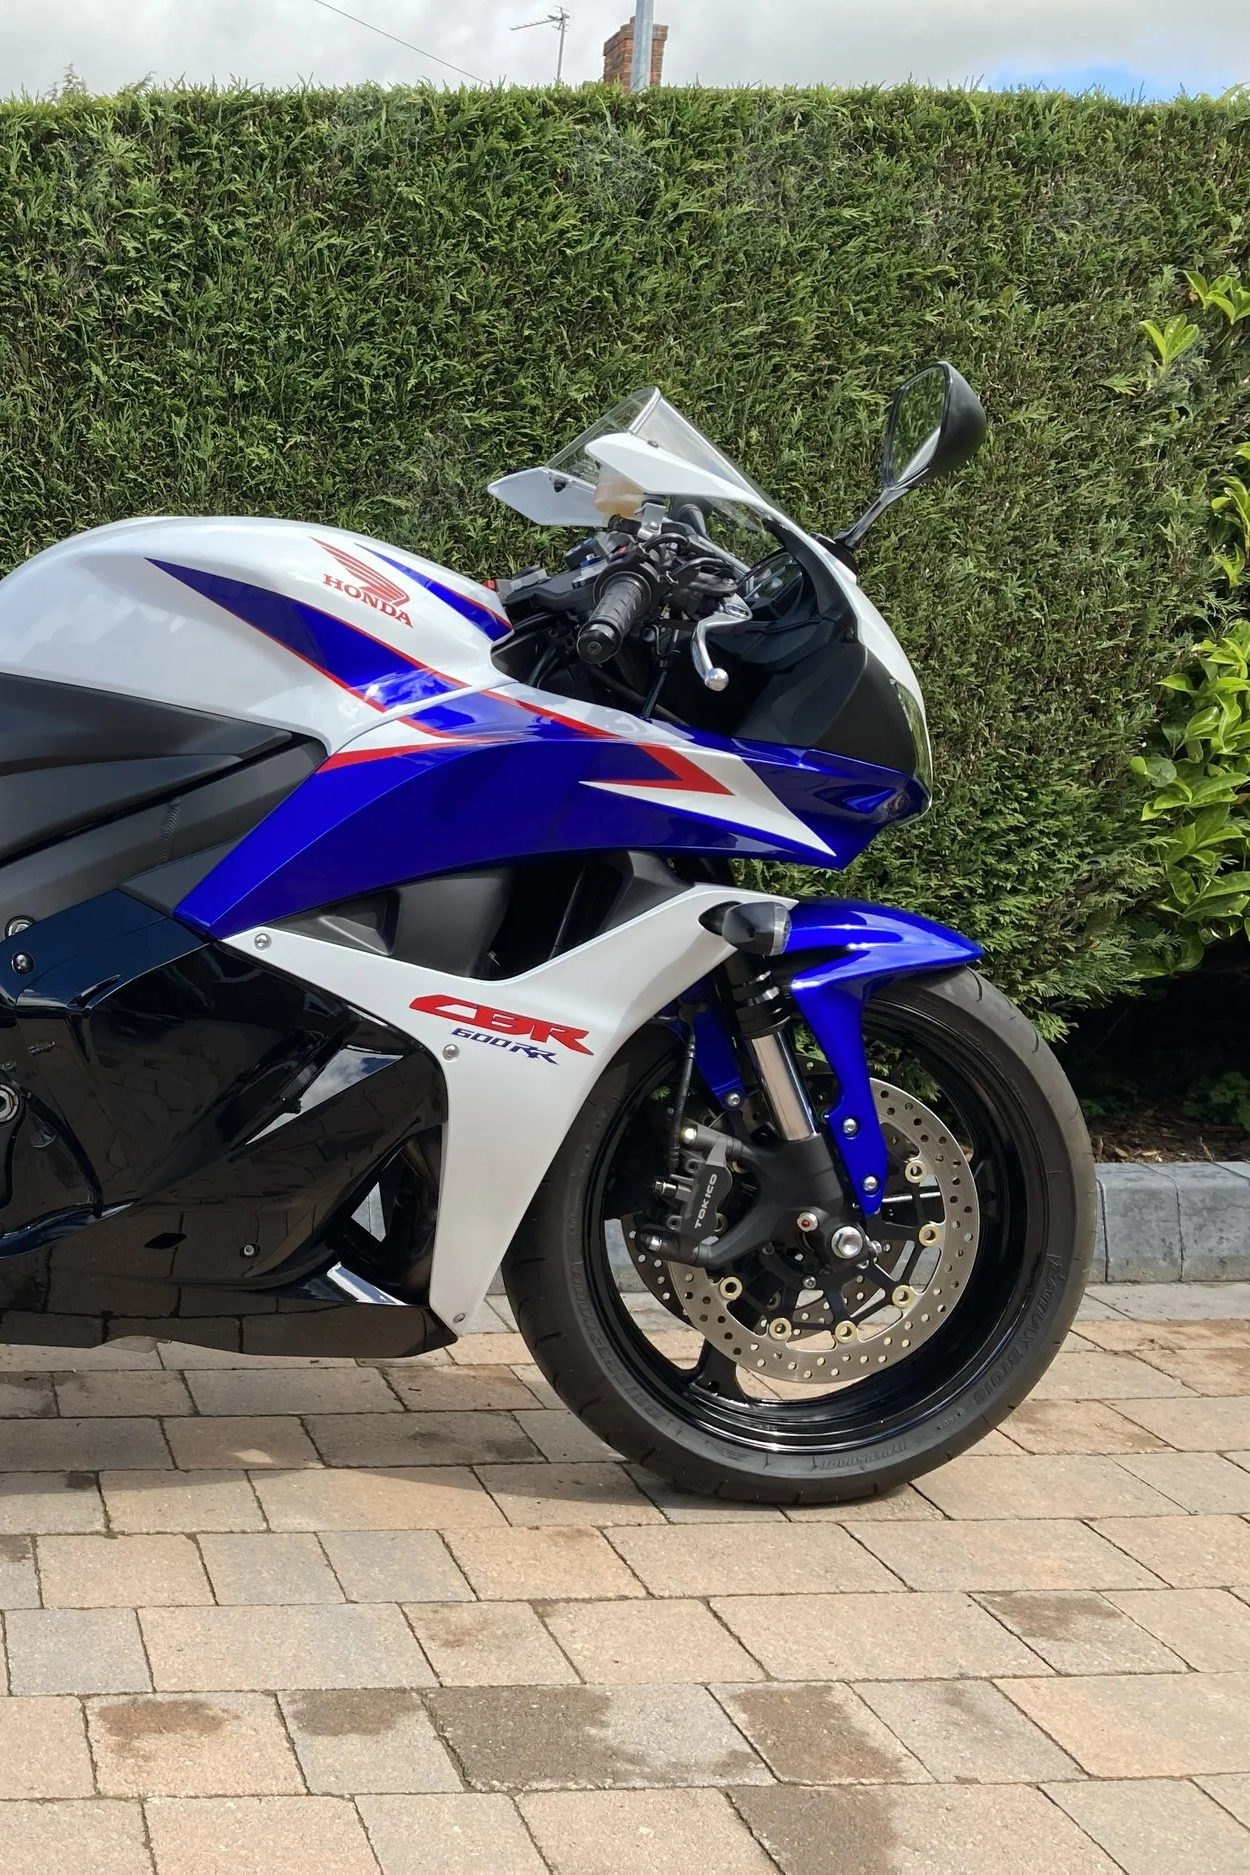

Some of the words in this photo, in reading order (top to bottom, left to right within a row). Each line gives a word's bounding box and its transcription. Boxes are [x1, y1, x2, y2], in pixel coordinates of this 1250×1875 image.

[322, 573, 414, 629] HONDA
[408, 994, 595, 1056] CBR
[450, 1027, 560, 1066] 600RR
[694, 1173, 718, 1230] TOKICO
